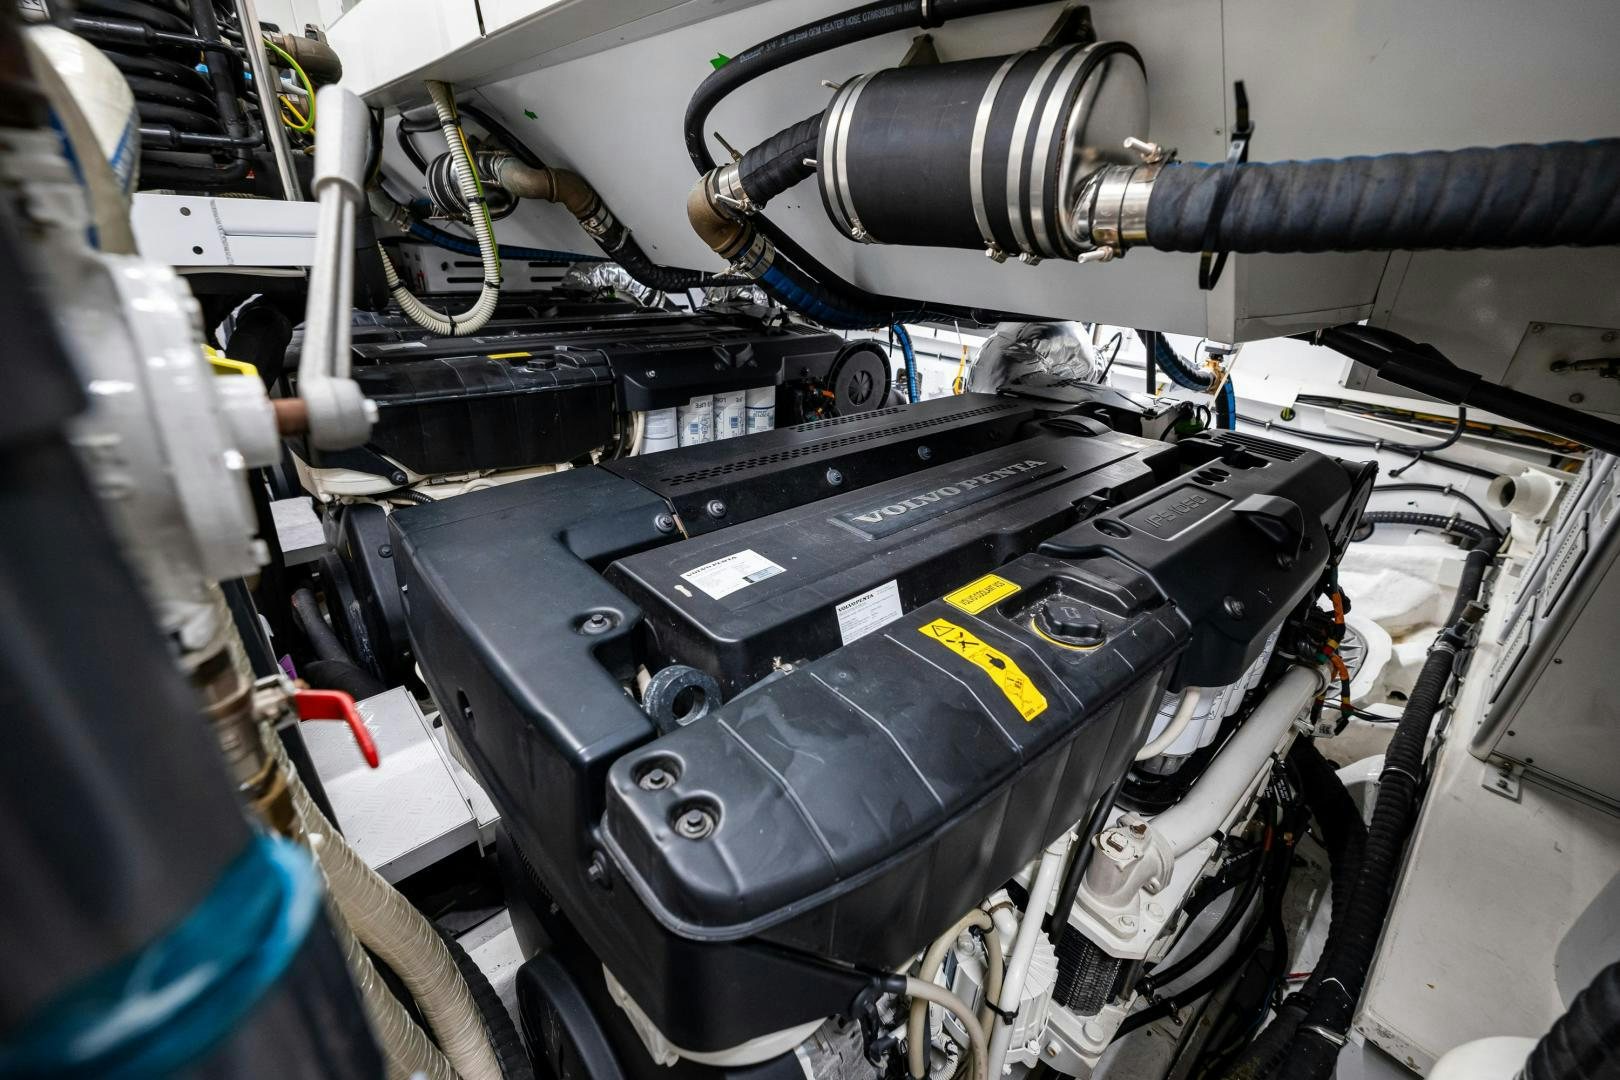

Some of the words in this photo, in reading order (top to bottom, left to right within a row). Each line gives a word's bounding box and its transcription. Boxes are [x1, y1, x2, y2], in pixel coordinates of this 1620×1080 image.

[822, 19, 844, 32] HEATER
[846, 14, 862, 26] HOSE
[853, 487, 960, 523] VOLVO
[957, 458, 1047, 491] PENTA
[838, 602, 856, 612] VOLVO
[855, 593, 874, 604] PENTA
